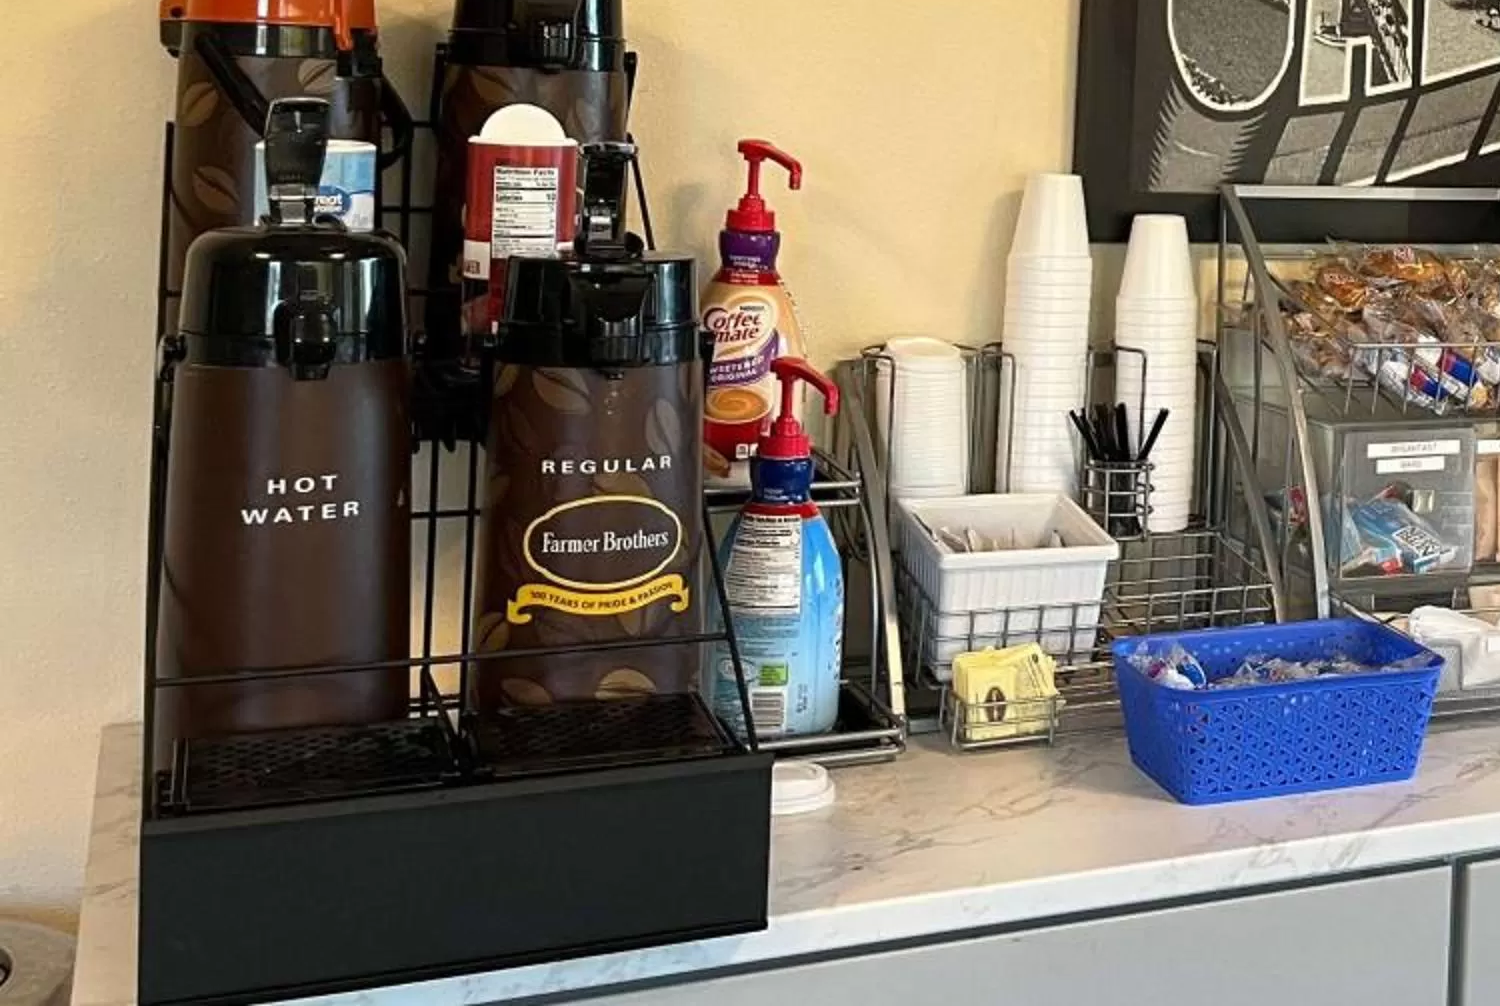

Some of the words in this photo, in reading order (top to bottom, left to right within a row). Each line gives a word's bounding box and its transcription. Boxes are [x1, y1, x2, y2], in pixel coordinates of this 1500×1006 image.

[703, 306, 763, 332] Coffee
[713, 326, 760, 344] mate
[709, 354, 765, 376] WEETENED
[541, 455, 673, 475] REGULAR
[267, 474, 338, 495] HOT
[240, 500, 360, 525] WATER
[541, 531, 601, 554] Farmer
[602, 528, 670, 552] Brothers
[548, 593, 579, 609] YEARS
[581, 600, 597, 610] OF
[599, 597, 627, 610] PRIDE
[629, 594, 639, 605] &
[638, 581, 674, 603] PASSION
